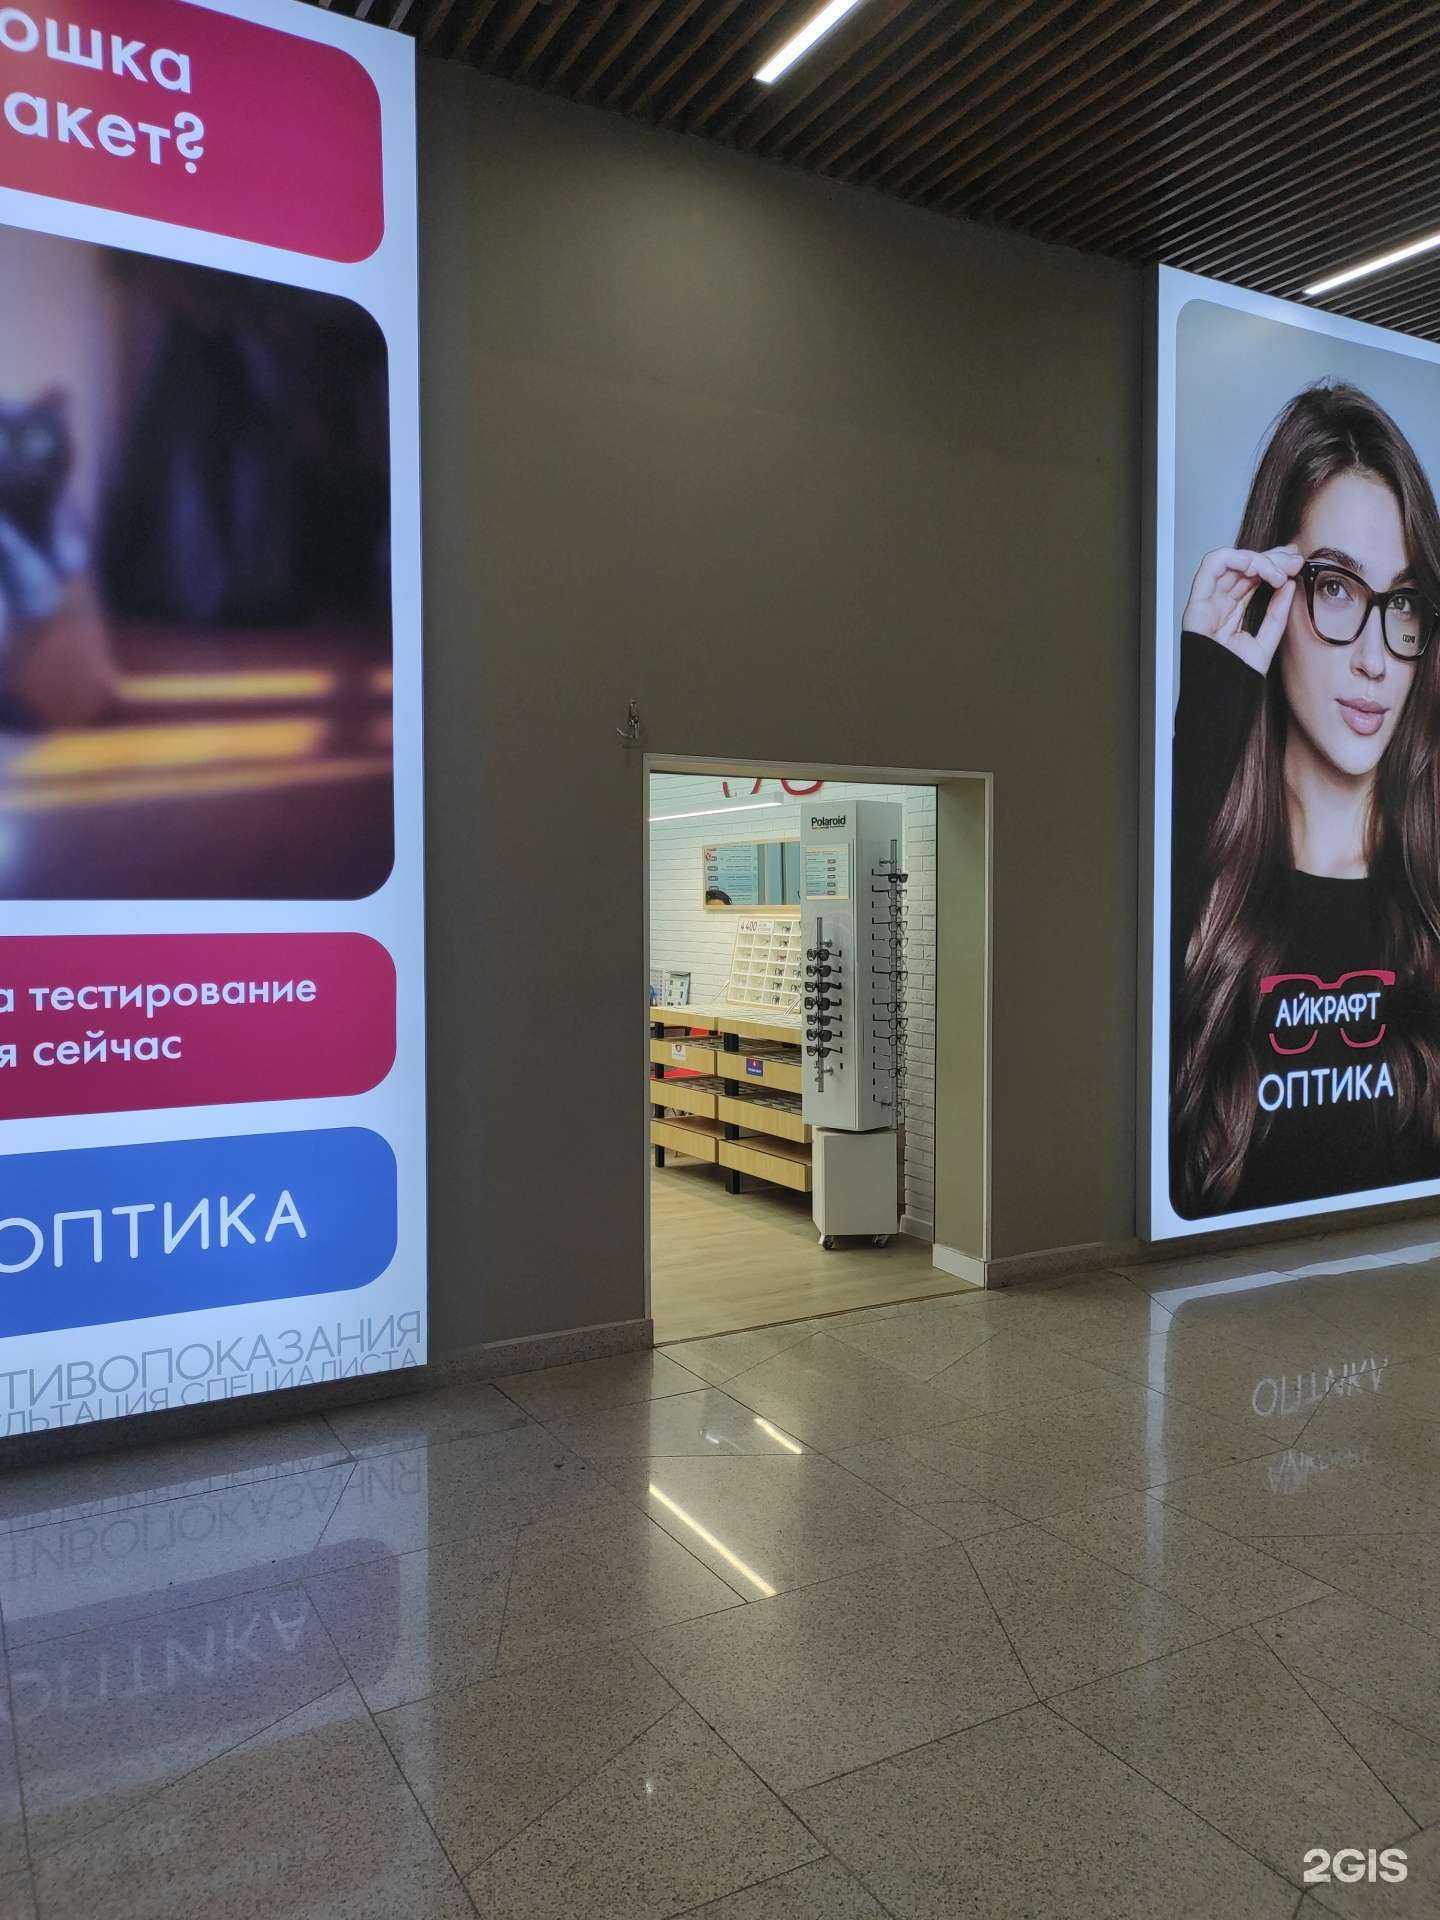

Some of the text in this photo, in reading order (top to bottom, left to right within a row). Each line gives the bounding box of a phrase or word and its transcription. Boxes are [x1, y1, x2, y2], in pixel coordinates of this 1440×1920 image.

[0, 8, 191, 94] ошка
[4, 92, 205, 174] акет?
[811, 816, 846, 827] Polaroid
[29, 979, 317, 1019] тестирование
[1275, 992, 1381, 1028] АЙКРАФТ
[33, 1030, 182, 1067] сейчас
[1258, 1062, 1394, 1112] ОПТИКА
[0, 1189, 308, 1274] ОПТИКА
[0, 1309, 421, 1410] ТИВОПОКАЗАНИЯ
